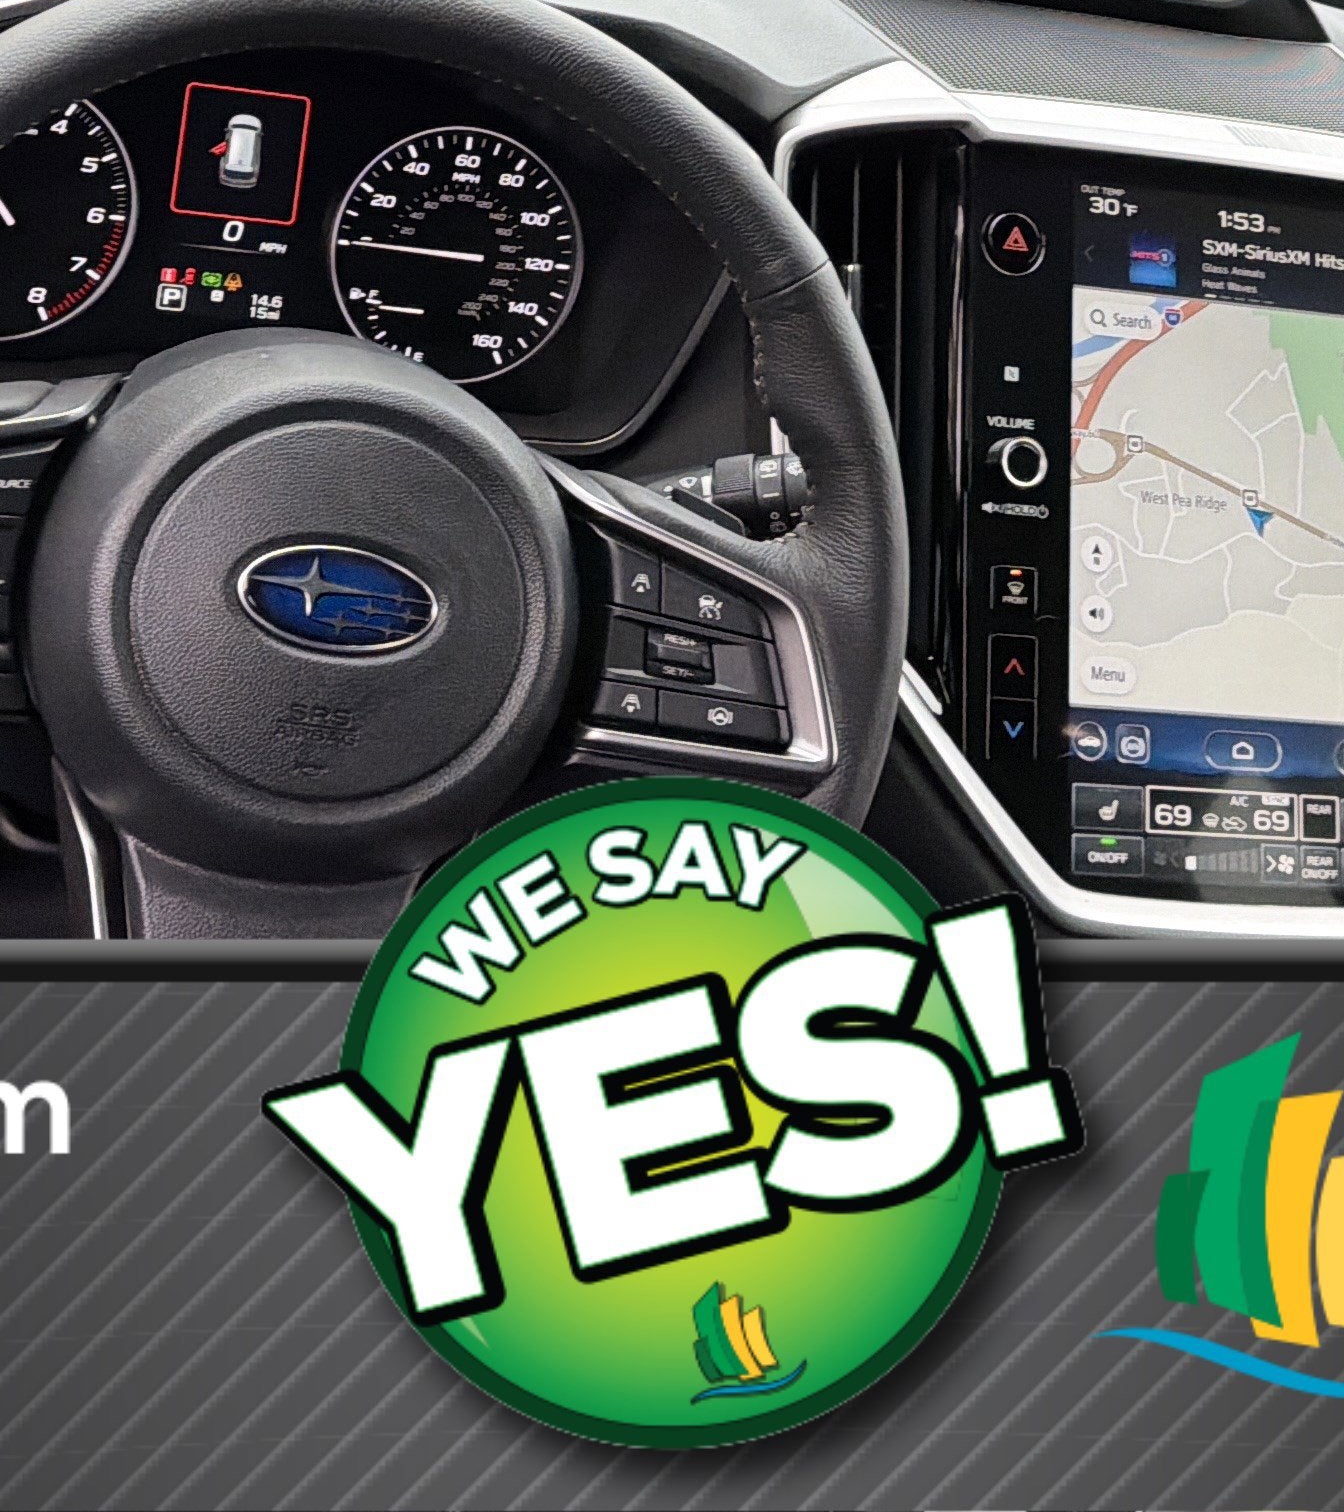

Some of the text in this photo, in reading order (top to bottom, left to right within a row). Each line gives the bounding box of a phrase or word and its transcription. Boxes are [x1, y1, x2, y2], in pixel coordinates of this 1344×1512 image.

[50, 119, 69, 135] 4
[80, 157, 100, 174] 5
[403, 162, 431, 176] 40
[455, 154, 481, 169] 60
[452, 173, 481, 185] MPH
[499, 173, 525, 188] 80
[370, 194, 397, 209] 20
[1088, 196, 1121, 216] 30
[86, 207, 106, 225] 6
[520, 212, 550, 226] 100
[1217, 210, 1265, 233] 1:53
[222, 220, 245, 242] 0
[259, 242, 289, 255] MPH
[1202, 239, 1311, 267] SXM-SiriusXM
[69, 256, 88, 272] 7
[524, 257, 554, 272] 120
[27, 287, 47, 304] 8
[162, 288, 181, 305] P
[251, 293, 283, 308] 14.6
[508, 301, 538, 316] 140
[1112, 312, 1153, 331] Search
[472, 334, 503, 349] 160
[986, 415, 1036, 430] VOLUME
[1140, 490, 1228, 513] West Pea Ridge
[1090, 665, 1126, 683] Menu
[1154, 803, 1193, 827] 69
[1306, 803, 1333, 816] REAR
[1253, 809, 1291, 832] 69
[1306, 855, 1334, 867] REAR
